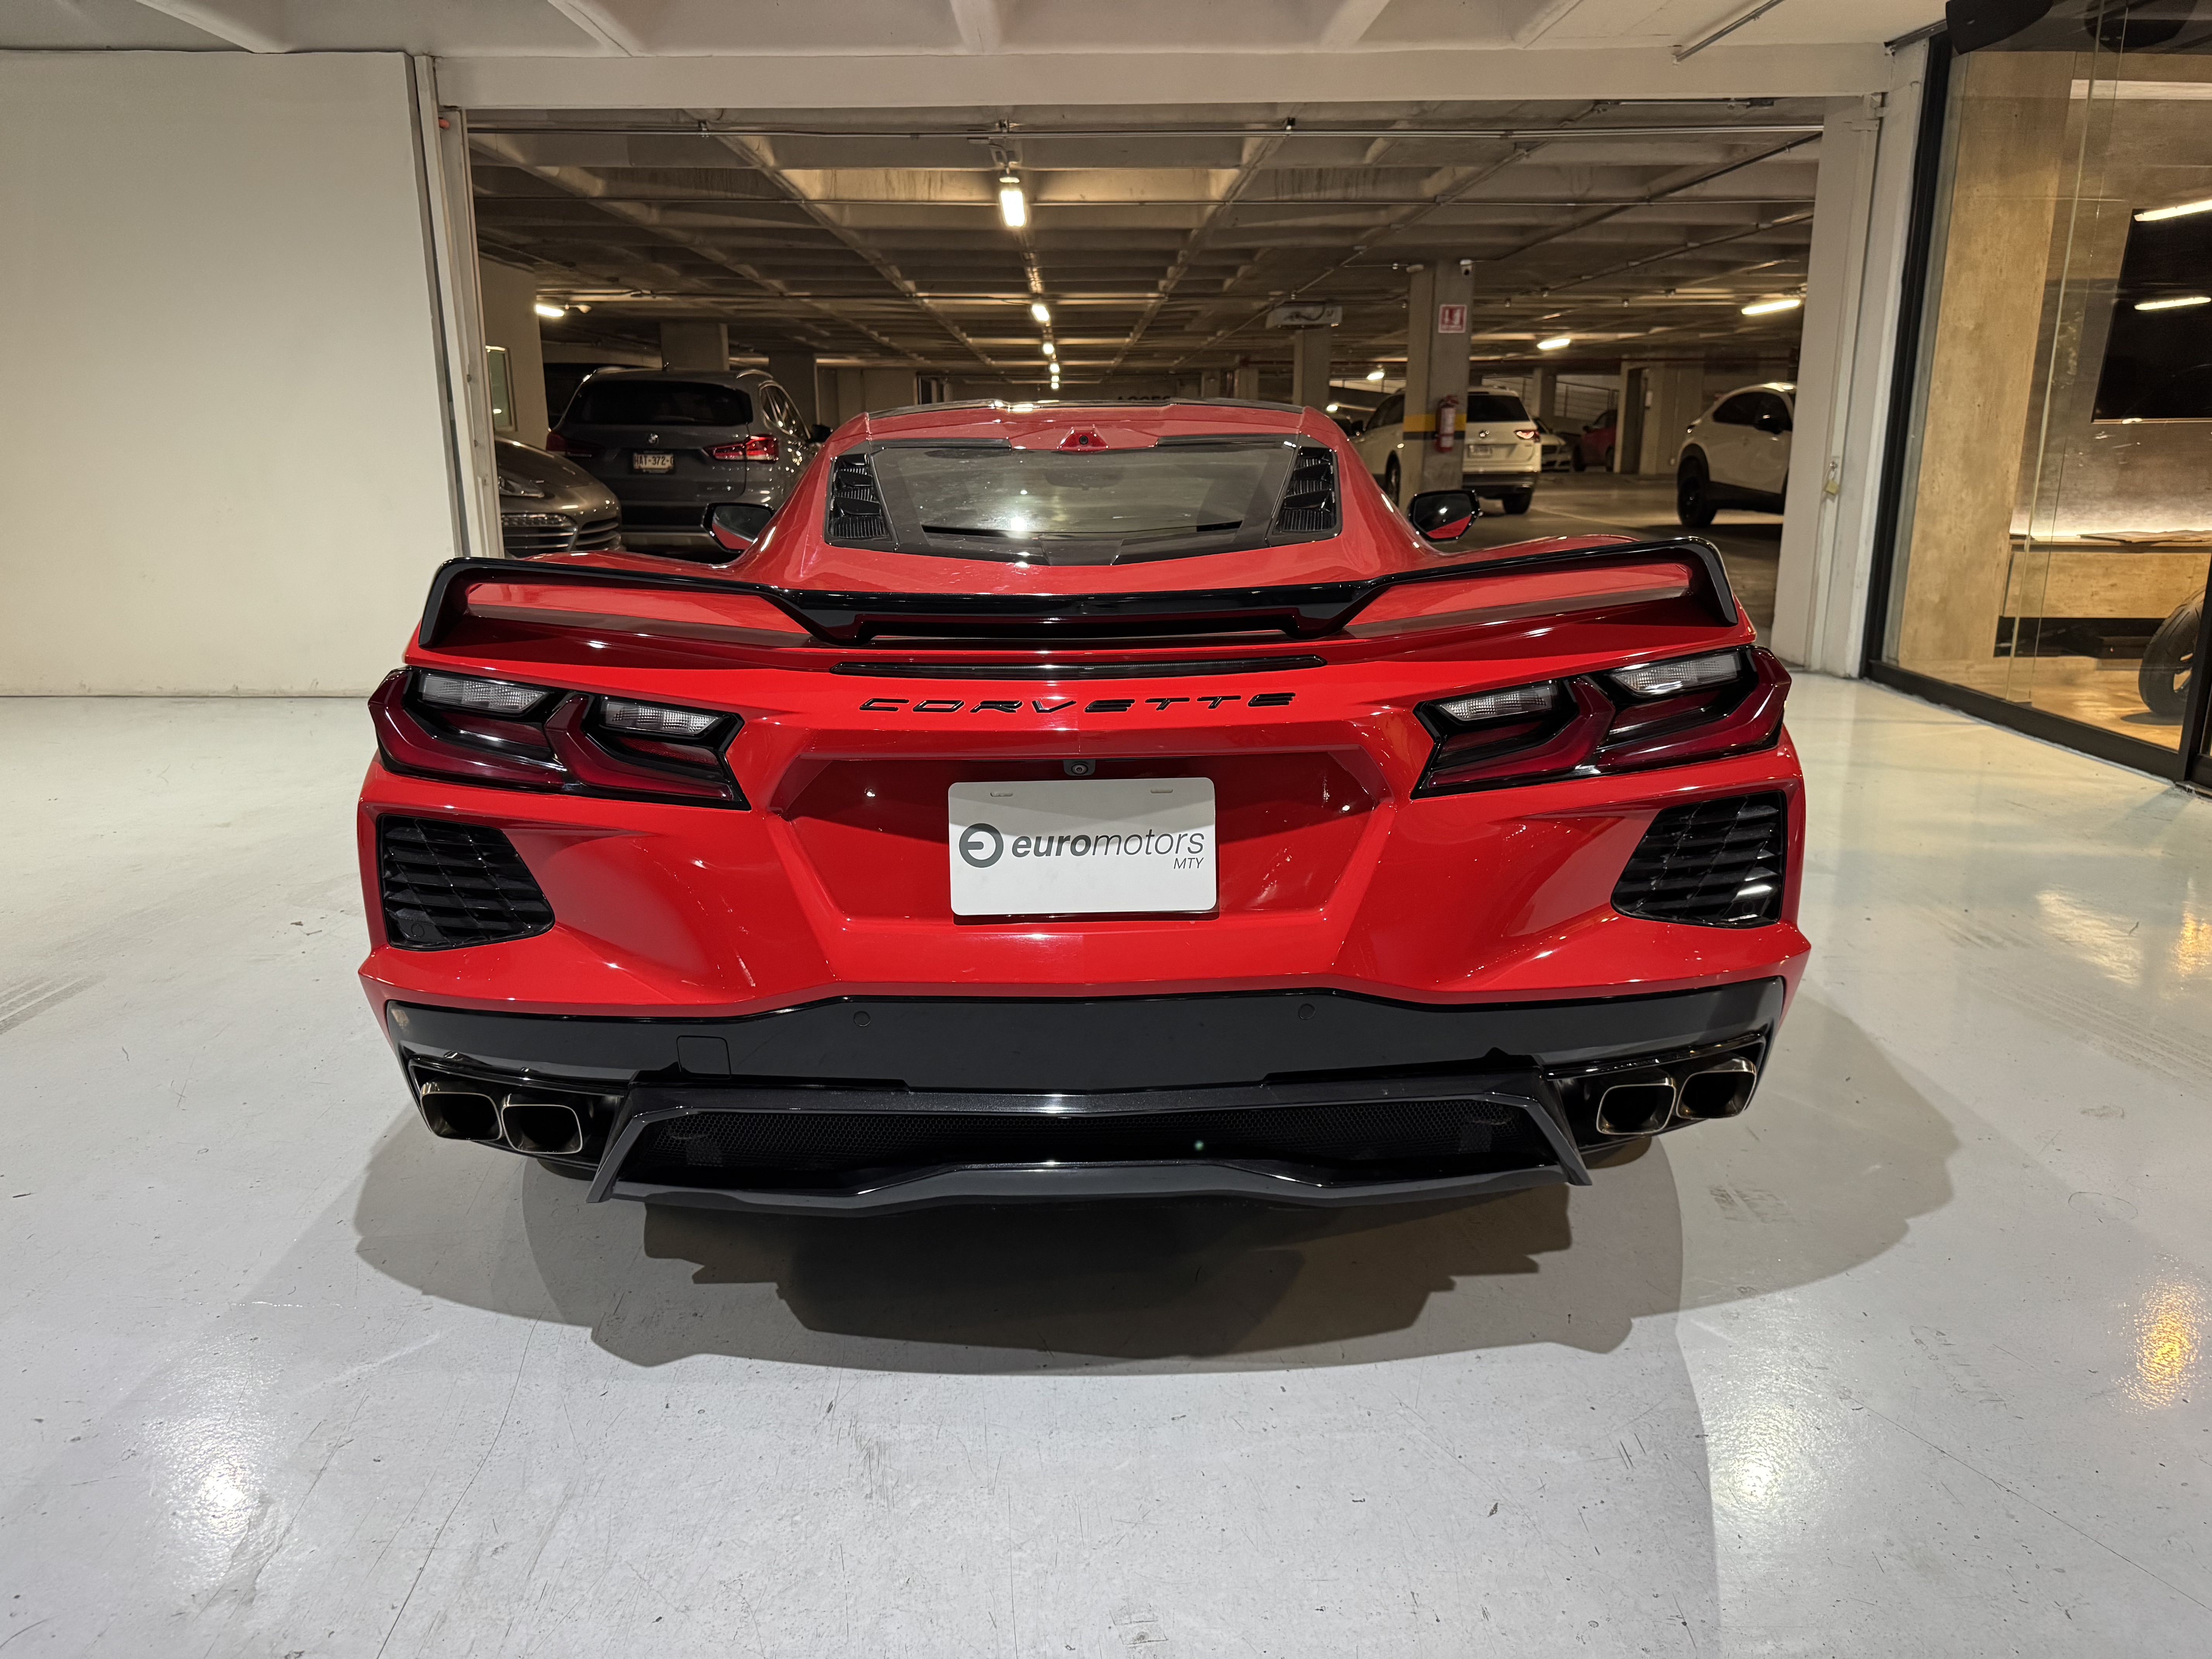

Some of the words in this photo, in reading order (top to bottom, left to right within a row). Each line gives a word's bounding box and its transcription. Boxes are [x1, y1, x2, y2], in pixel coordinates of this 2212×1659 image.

[859, 692, 1295, 713] CORVETTE
[1012, 829, 1204, 857] euromotors
[1174, 857, 1204, 869] MTY
